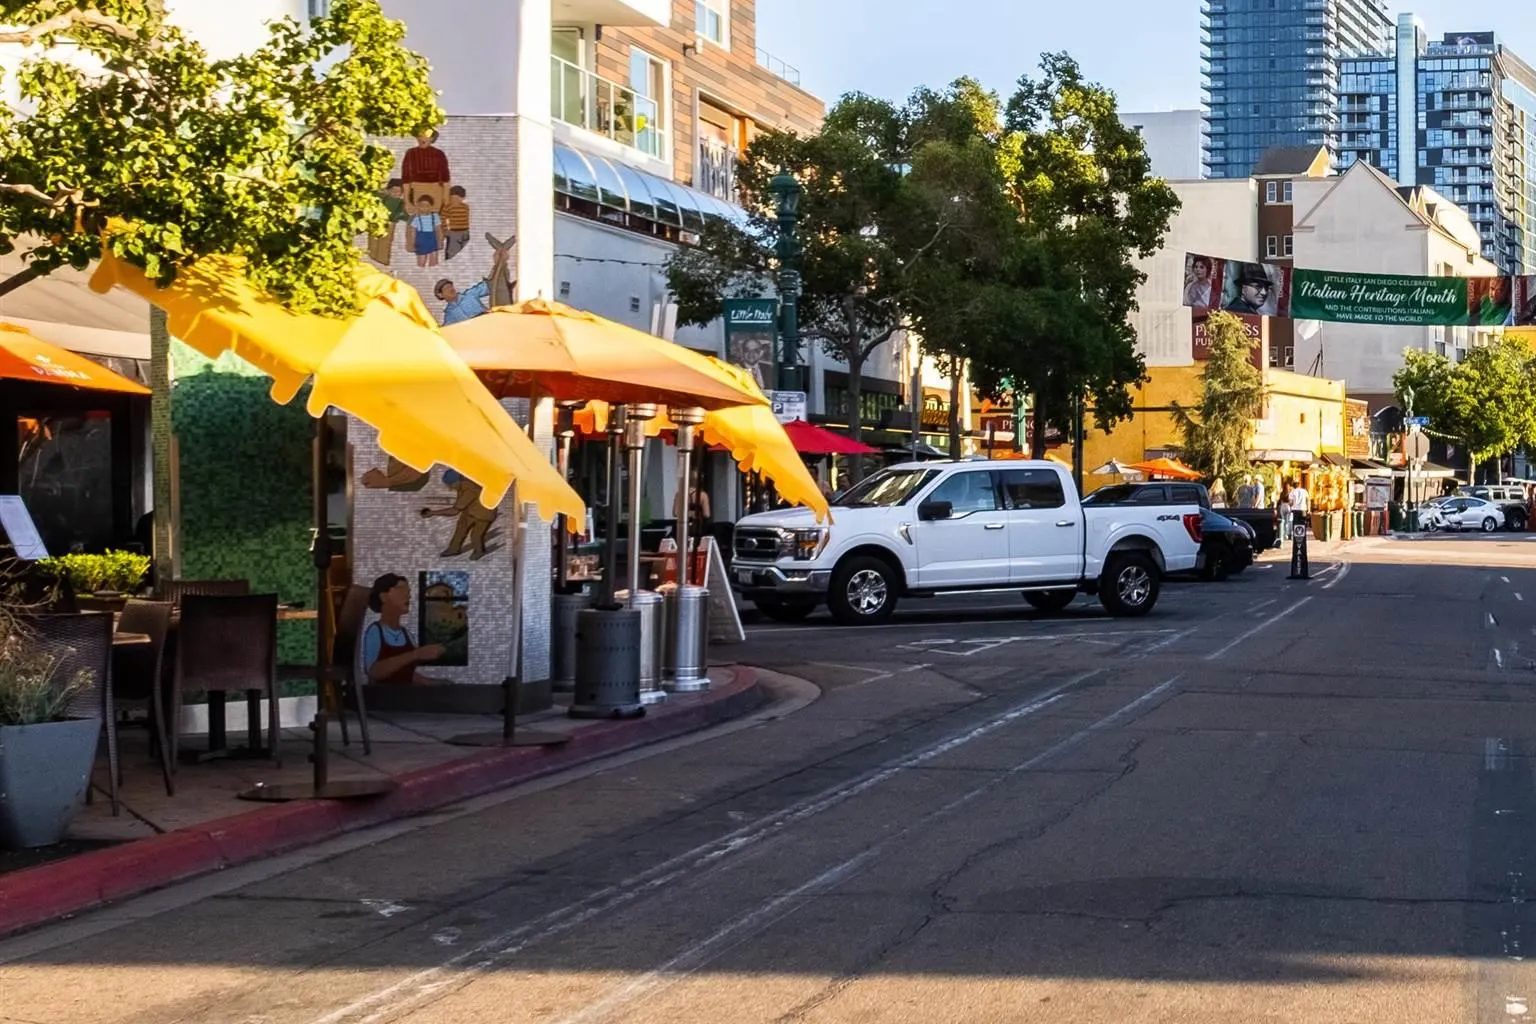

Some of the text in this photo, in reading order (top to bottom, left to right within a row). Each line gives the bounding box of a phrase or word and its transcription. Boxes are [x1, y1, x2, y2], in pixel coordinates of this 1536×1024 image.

[1300, 280, 1347, 300] Italian
[1350, 285, 1408, 307] Heritage
[1408, 288, 1457, 307] Month
[1354, 306, 1406, 314] CONTRIBUTIONS
